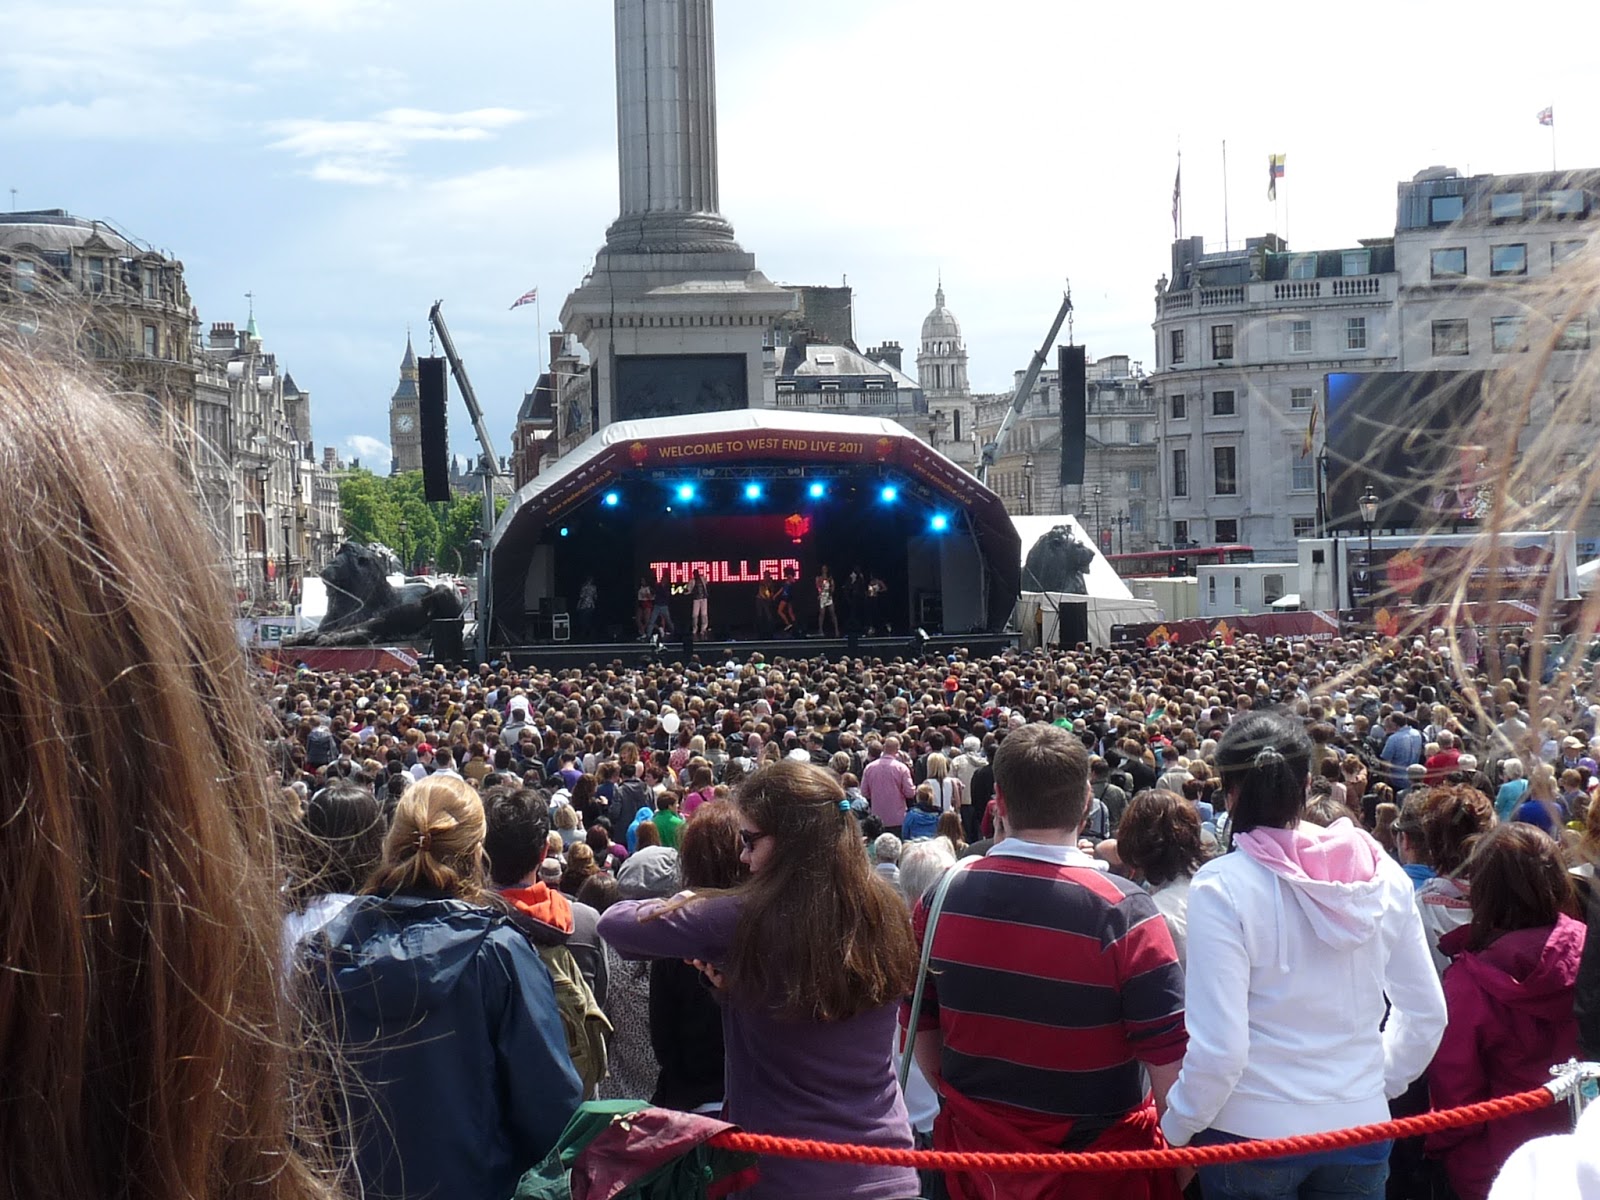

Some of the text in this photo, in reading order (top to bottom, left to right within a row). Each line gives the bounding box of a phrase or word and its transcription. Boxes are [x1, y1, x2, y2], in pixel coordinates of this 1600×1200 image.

[658, 438, 864, 458] WELCOME TO WEST END LIVE 2011
